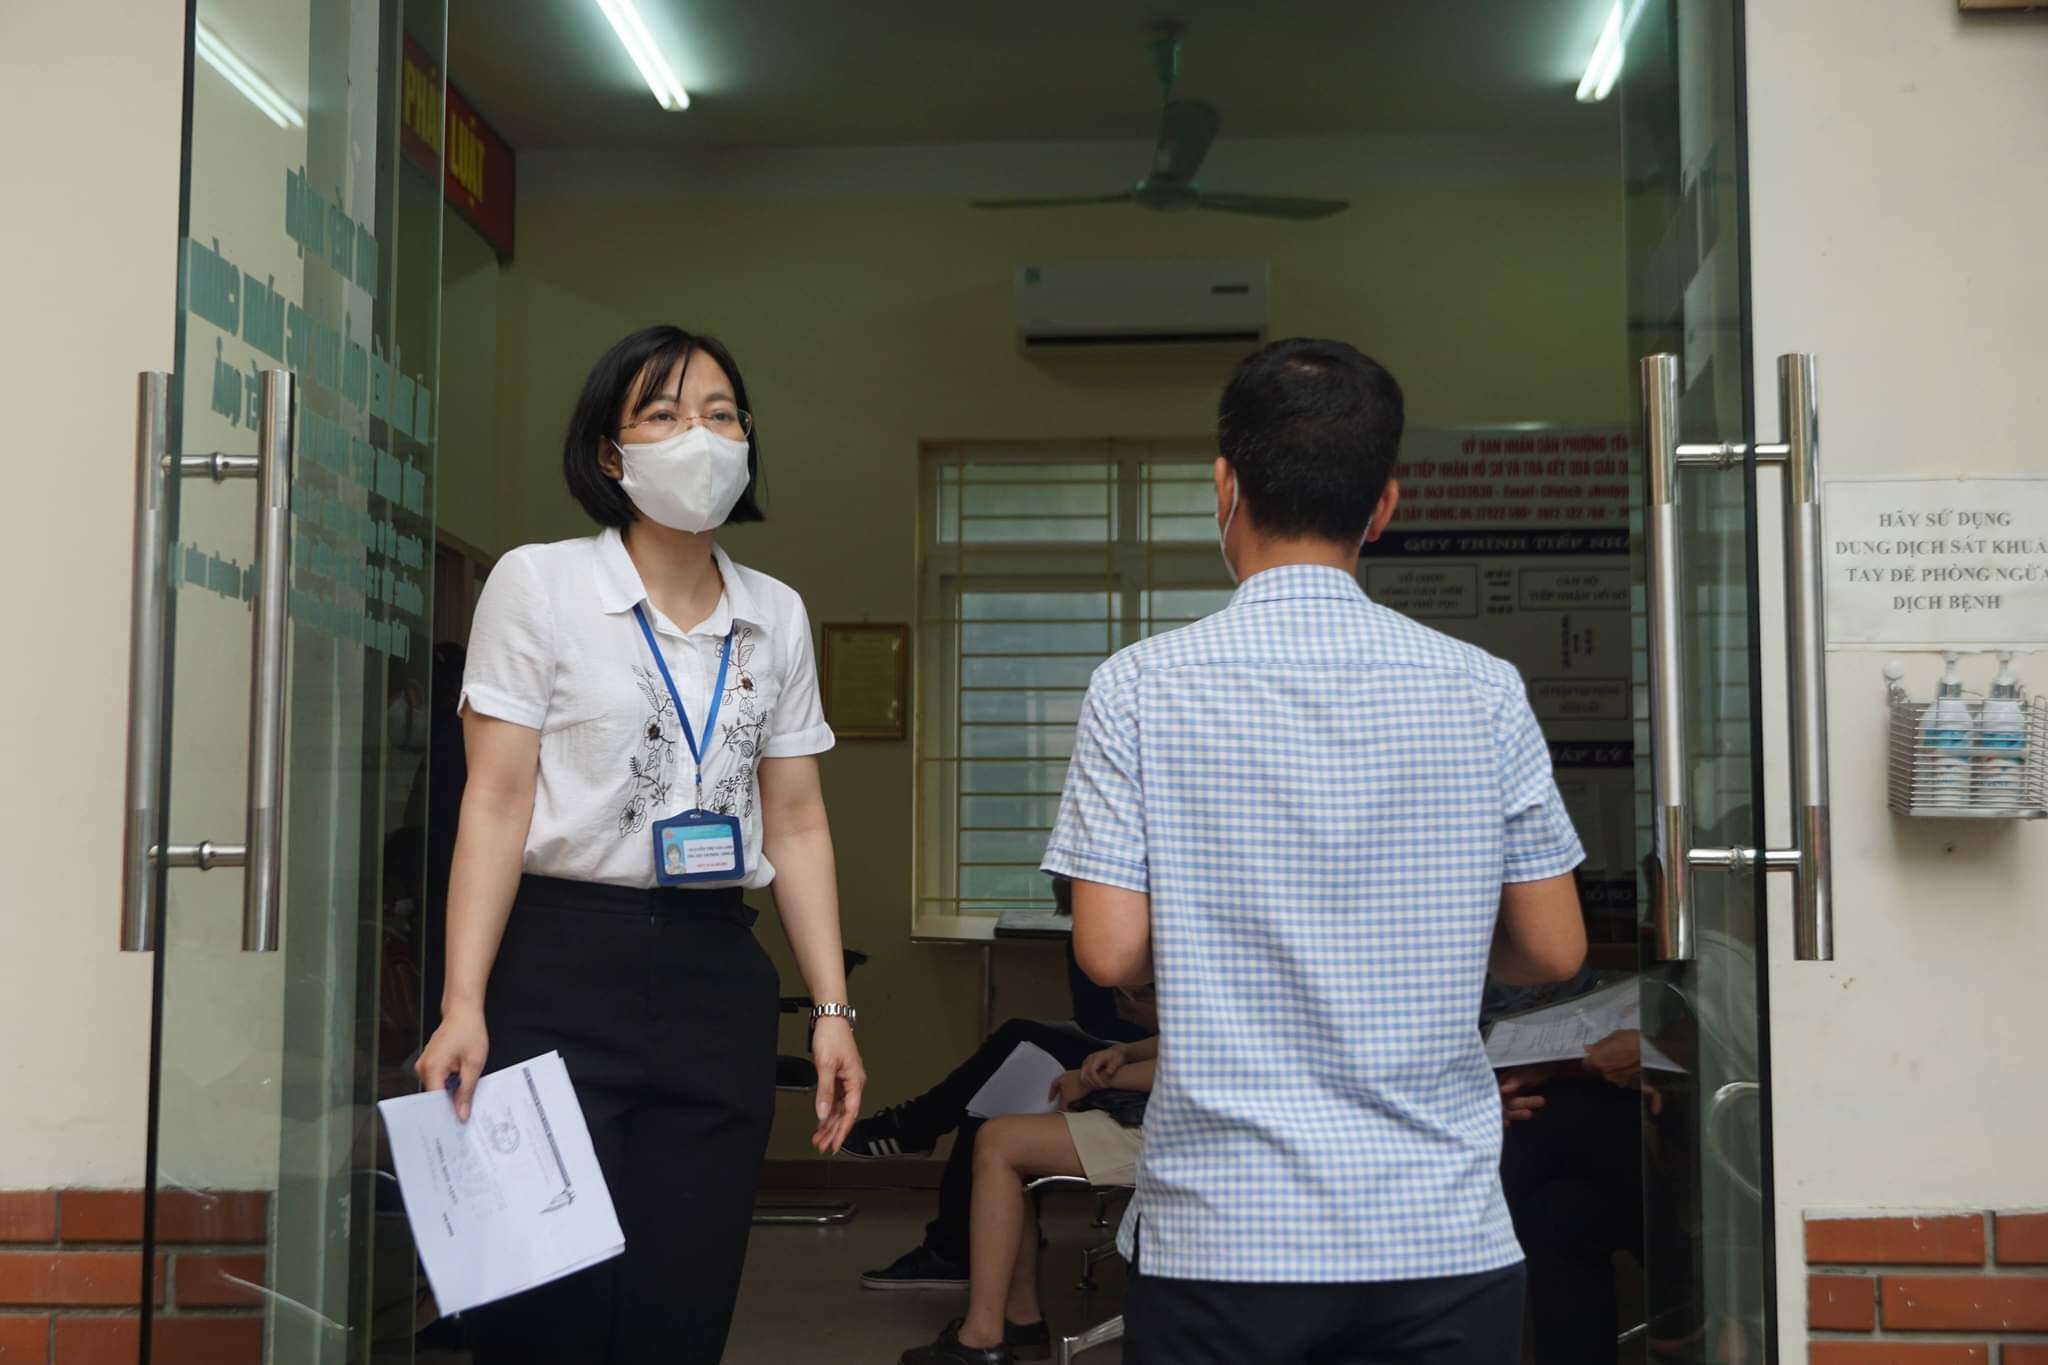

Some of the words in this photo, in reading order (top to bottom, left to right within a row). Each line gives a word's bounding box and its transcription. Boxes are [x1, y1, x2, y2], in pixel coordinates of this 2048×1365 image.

[1479, 438, 1502, 453] BAN
[1505, 436, 1535, 453] NHÂN
[1537, 435, 1560, 452] DÂN
[1413, 461, 1436, 477] TIẾP
[1438, 460, 1468, 477] NHẬN
[1879, 510, 1920, 528] HÃY
[1957, 511, 2011, 530] DỤNG
[1403, 539, 1450, 552] QUY
[1457, 536, 1526, 550] TRÌNH
[1533, 533, 1584, 549] TIẾP
[1835, 541, 1891, 555] DUNG
[1896, 540, 1945, 558] DỊCH
[1950, 535, 1987, 554] SÁT
[1991, 536, 2048, 555] KHUẨ
[1846, 568, 1884, 583] TAY
[1920, 563, 1990, 583] PHÒNG
[1892, 595, 1942, 614] DỊCH
[1948, 593, 2002, 614] BỆNH
